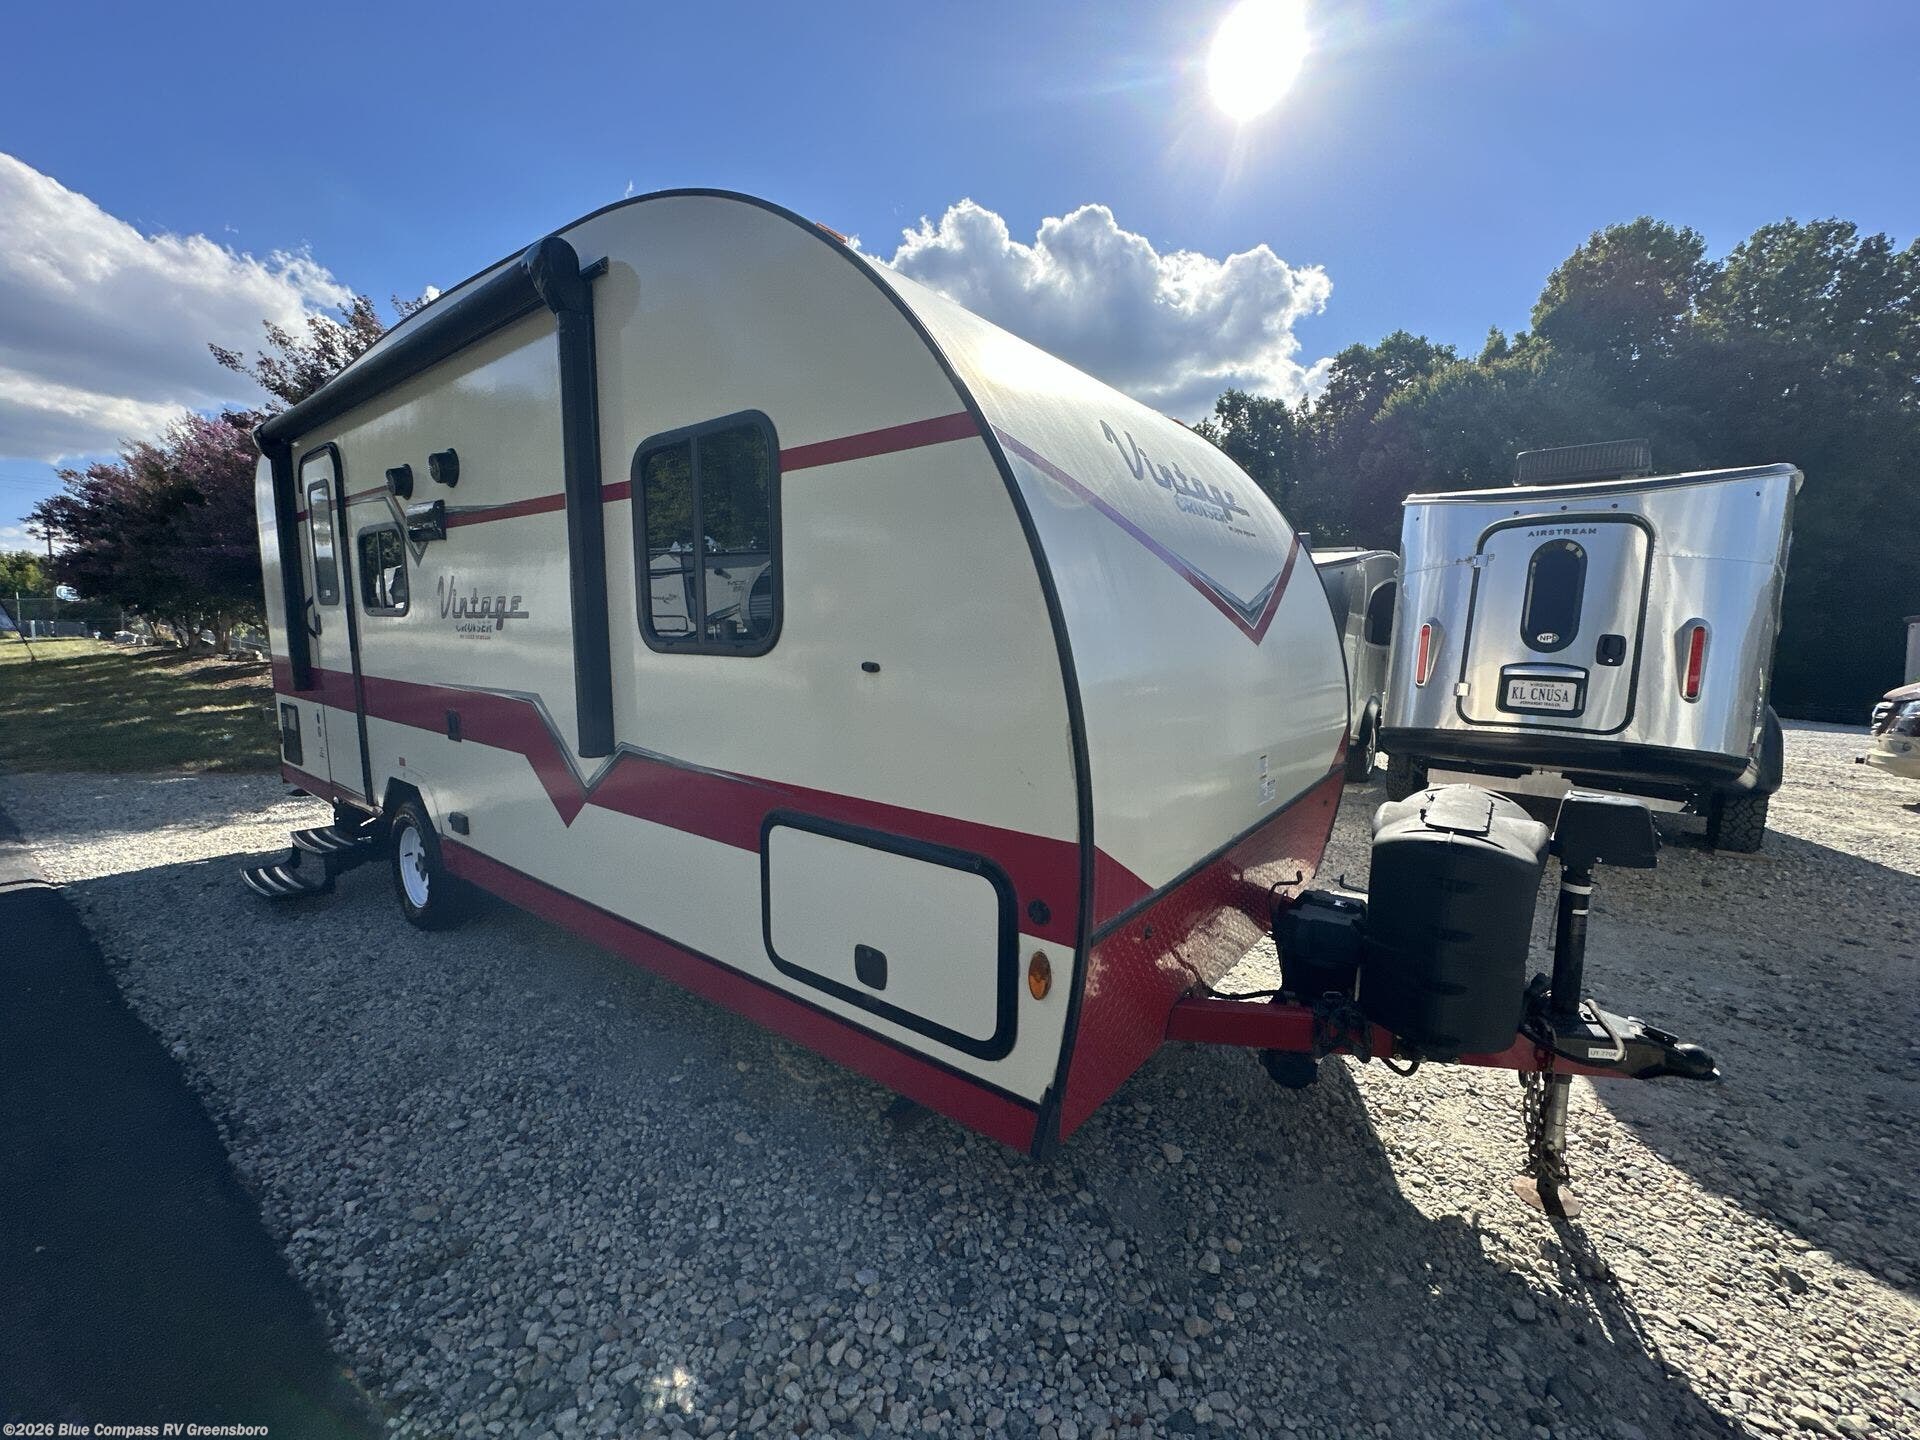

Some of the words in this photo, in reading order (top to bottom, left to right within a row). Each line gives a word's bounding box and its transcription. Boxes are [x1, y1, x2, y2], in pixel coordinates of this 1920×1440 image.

[1099, 419, 1250, 522] Vintage
[1527, 528, 1597, 537] AIRSTREAM
[437, 575, 529, 631] Vintage
[1530, 687, 1569, 702] CNUSA
